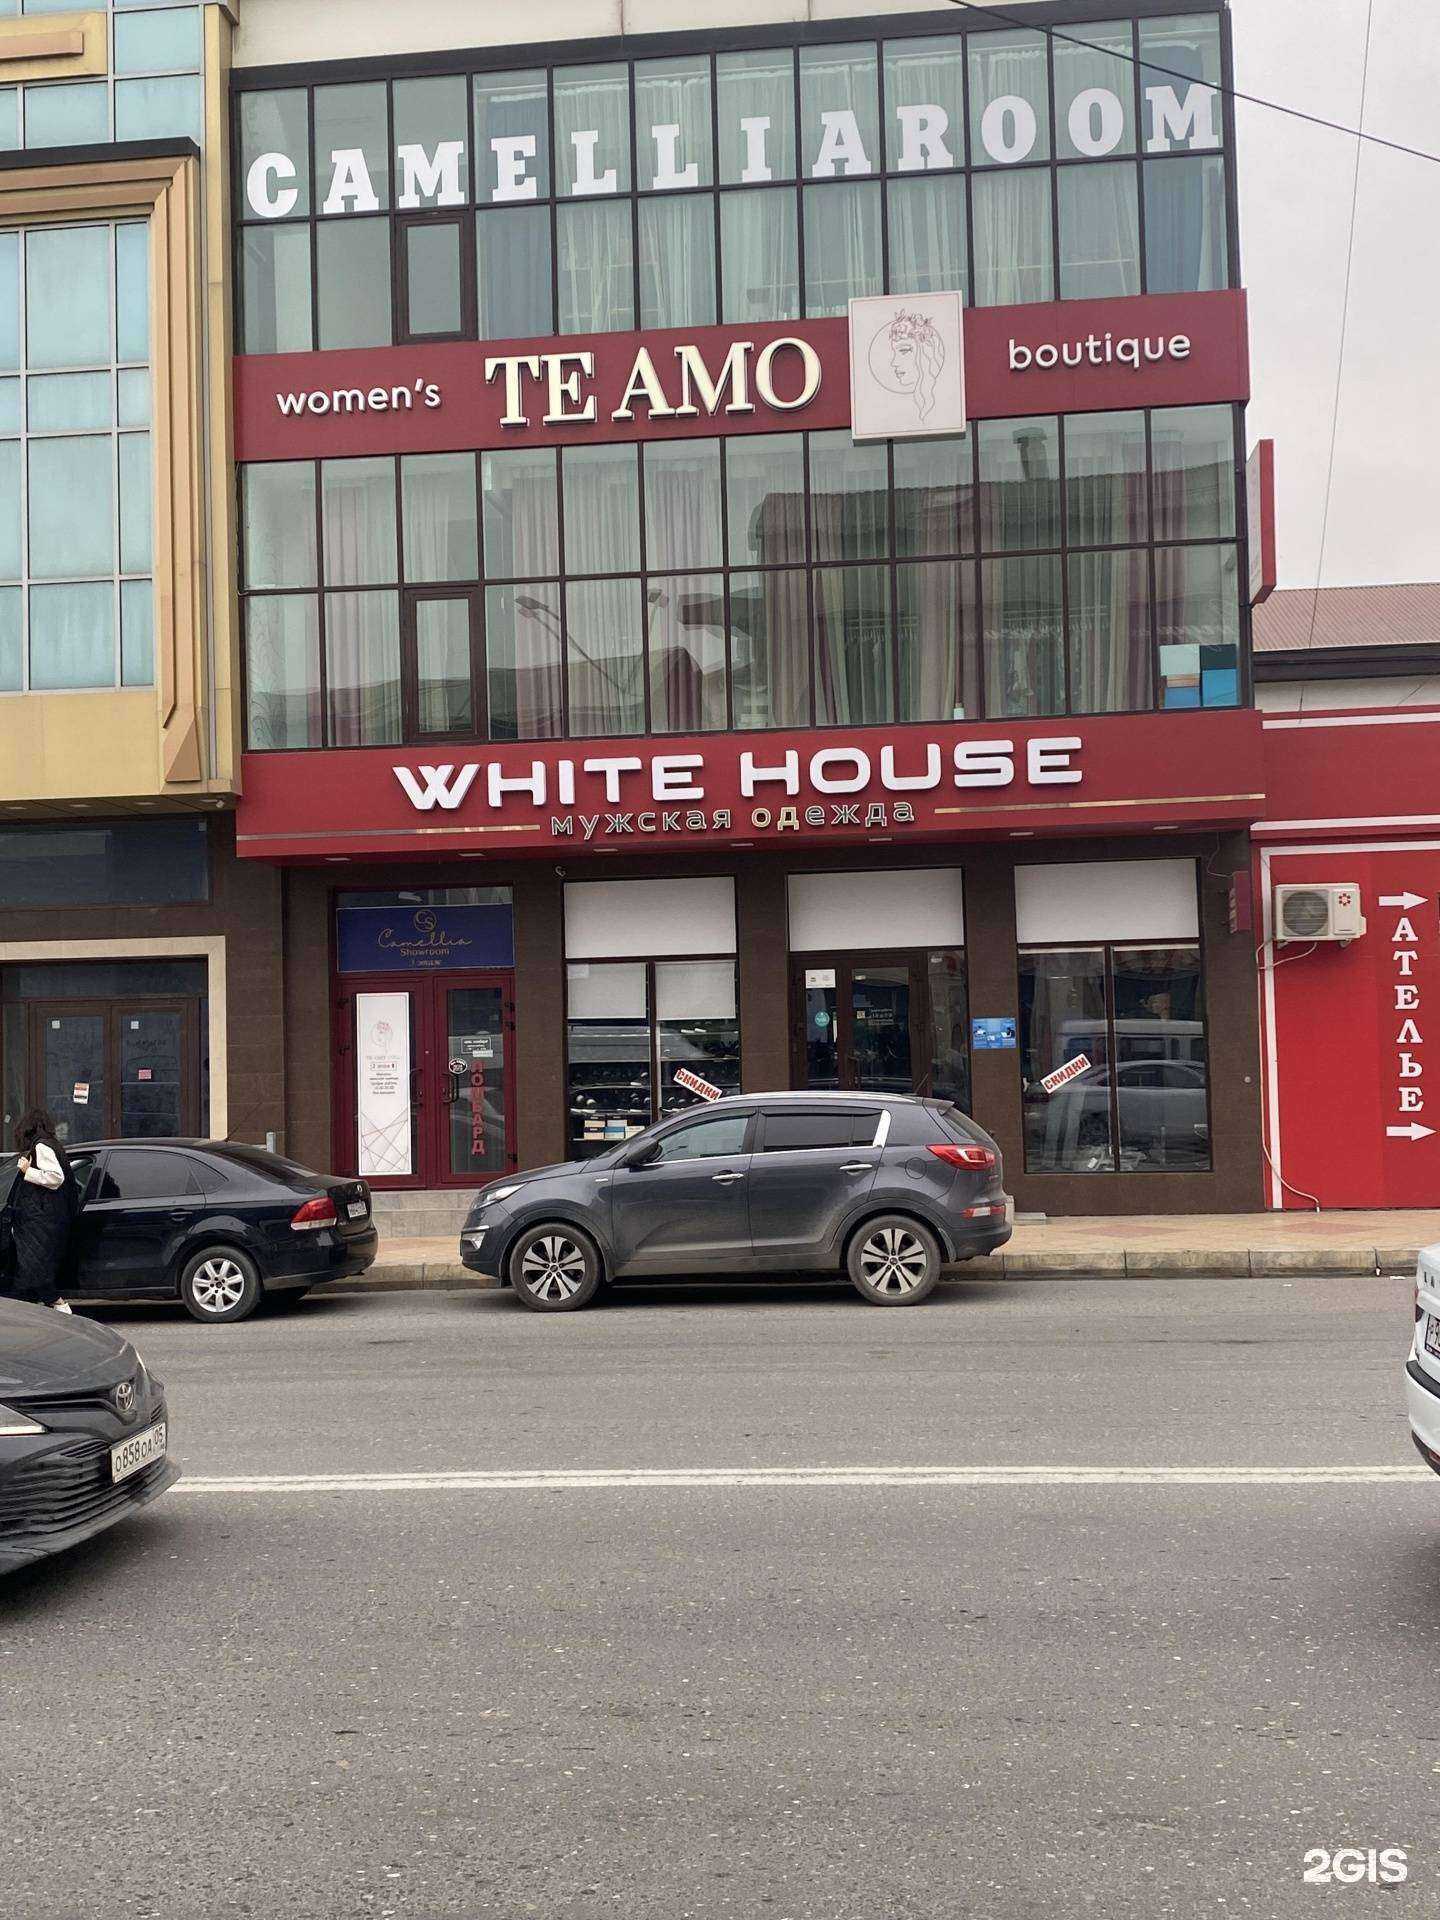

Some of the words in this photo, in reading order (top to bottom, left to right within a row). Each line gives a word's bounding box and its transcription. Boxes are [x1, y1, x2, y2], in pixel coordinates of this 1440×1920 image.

[246, 81, 1220, 218] CAMELLIAROOM
[1009, 333, 1191, 371] boutique
[276, 378, 441, 415] women's
[485, 351, 598, 429] TE
[611, 336, 822, 421] AMO
[392, 754, 705, 811] WHITE
[740, 736, 1084, 797] HOUSE
[551, 808, 732, 840] мужская
[751, 800, 915, 831] одежда
[400, 948, 449, 957] Showroom
[1391, 917, 1424, 1112] АТЕЛЬЕ
[676, 1069, 720, 1100] СКИДКИ
[1044, 1057, 1088, 1089] СКИДКИ
